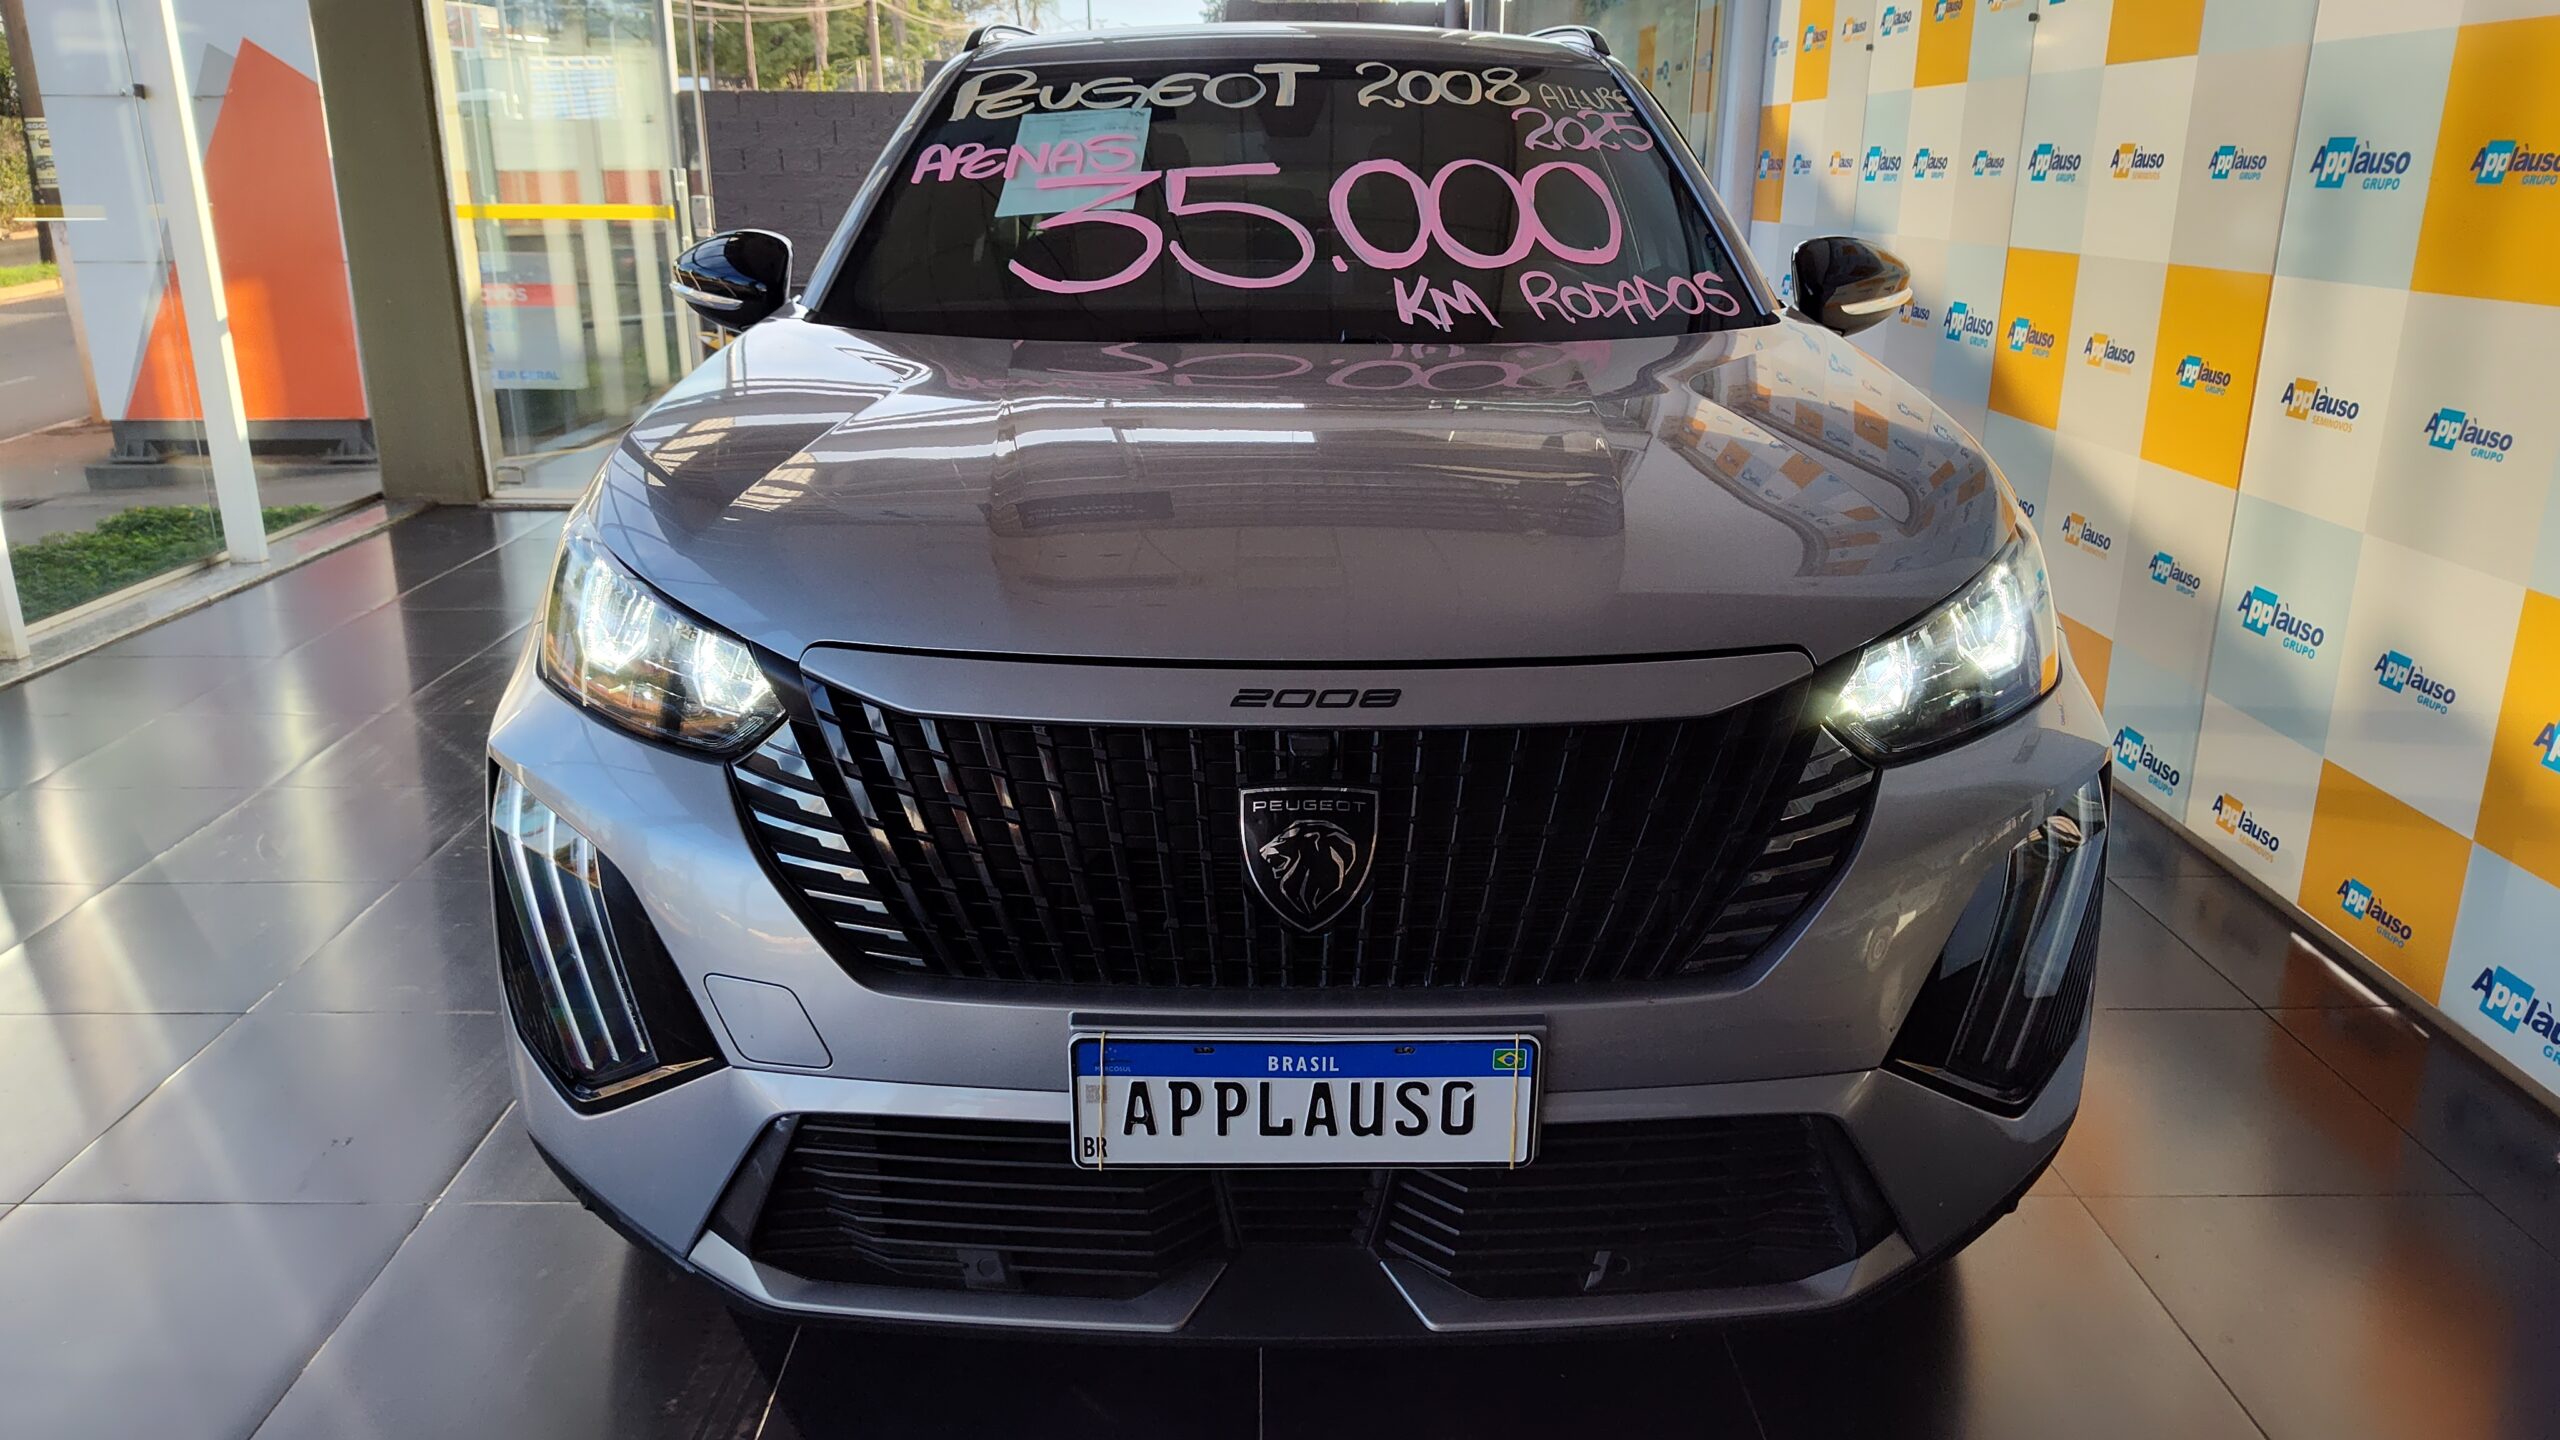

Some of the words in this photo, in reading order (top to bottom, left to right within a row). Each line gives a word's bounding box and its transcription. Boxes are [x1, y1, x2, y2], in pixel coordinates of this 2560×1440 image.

[948, 62, 1320, 121] PEUGEOT
[1355, 61, 1531, 108] 2008
[1539, 83, 1634, 112] ALLURE
[1511, 106, 1654, 152] 2025
[911, 134, 1138, 185] APENAS
[2362, 177, 2401, 190] GRUPO
[1008, 158, 1623, 294] 35.000
[1393, 275, 1504, 332] KM
[1518, 270, 1741, 325] RODADOS
[2470, 447, 2504, 463] GRUPO
[2282, 637, 2316, 660] GRUPO
[1229, 688, 1403, 709] 2008
[2416, 693, 2448, 715] GRUPO
[1252, 799, 1368, 813] PEUGEOT
[1267, 1055, 1340, 1073] BRASIL
[1122, 1080, 1477, 1137] APPLAUSO
[1083, 1136, 1108, 1158] BR
